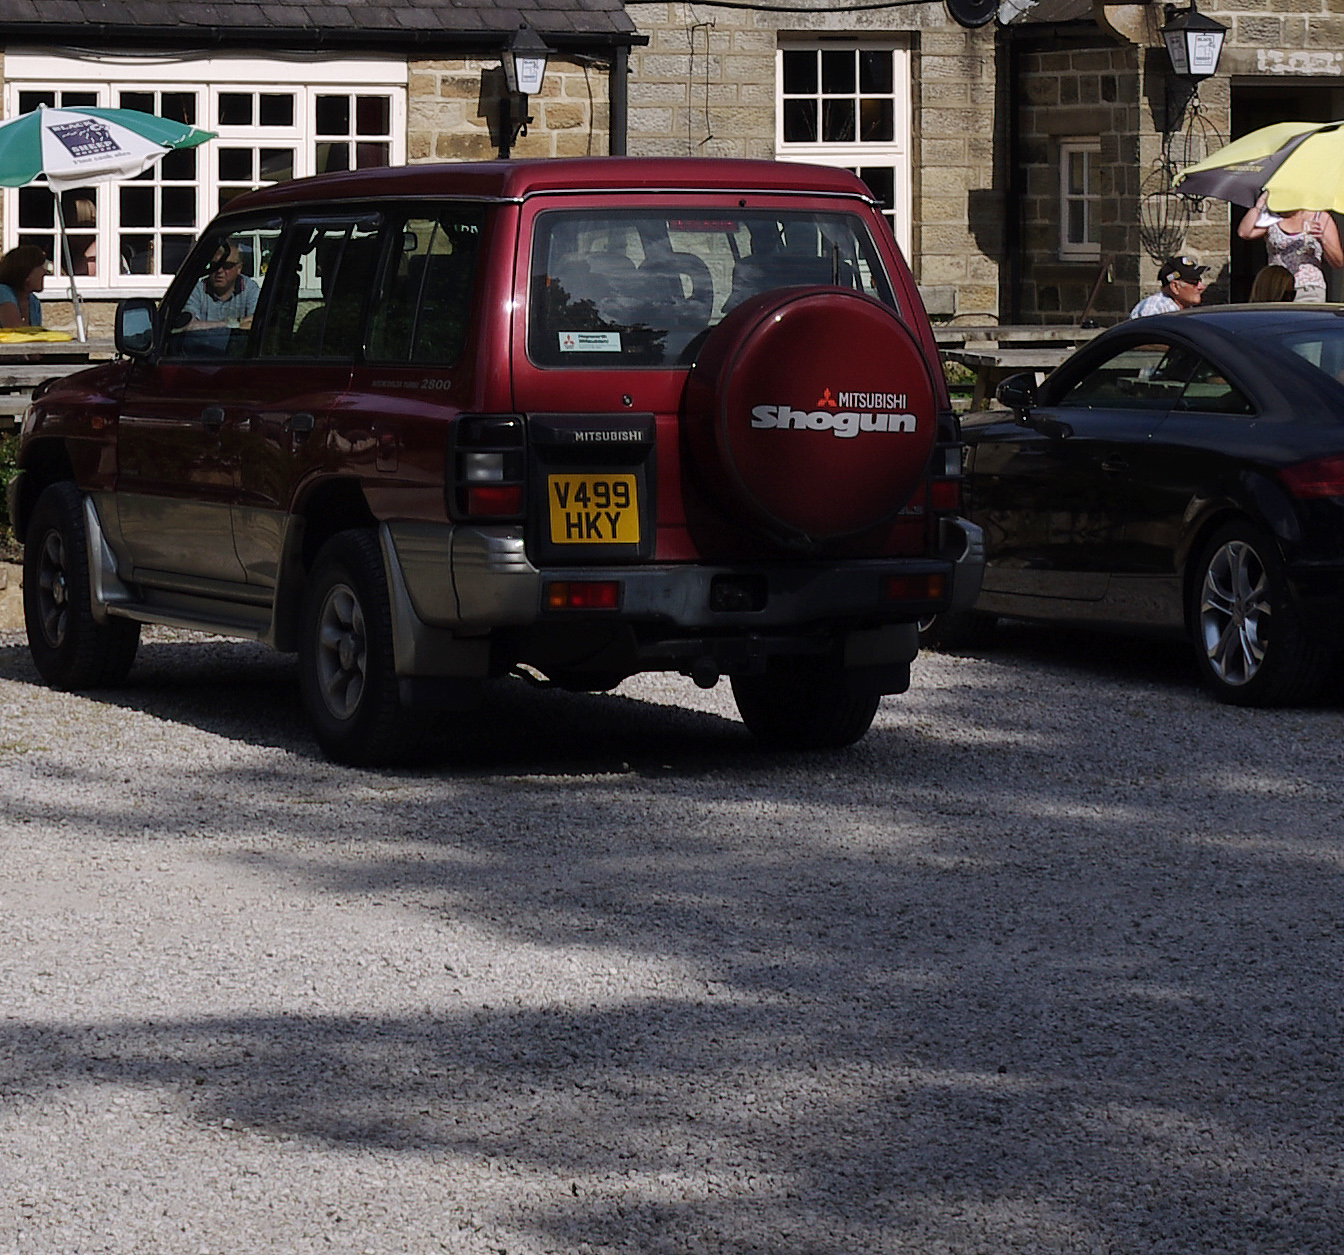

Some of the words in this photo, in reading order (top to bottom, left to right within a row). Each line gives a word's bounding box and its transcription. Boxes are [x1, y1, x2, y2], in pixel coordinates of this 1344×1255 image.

[51, 120, 94, 132] BLACK
[71, 140, 113, 153] SHEEP
[420, 379, 452, 390] 2800
[838, 392, 907, 409] MITSUBISHI
[751, 404, 917, 438] Shogun
[575, 431, 643, 441] MITSUBISHI
[553, 481, 631, 509] V499
[565, 512, 621, 539] HKY
